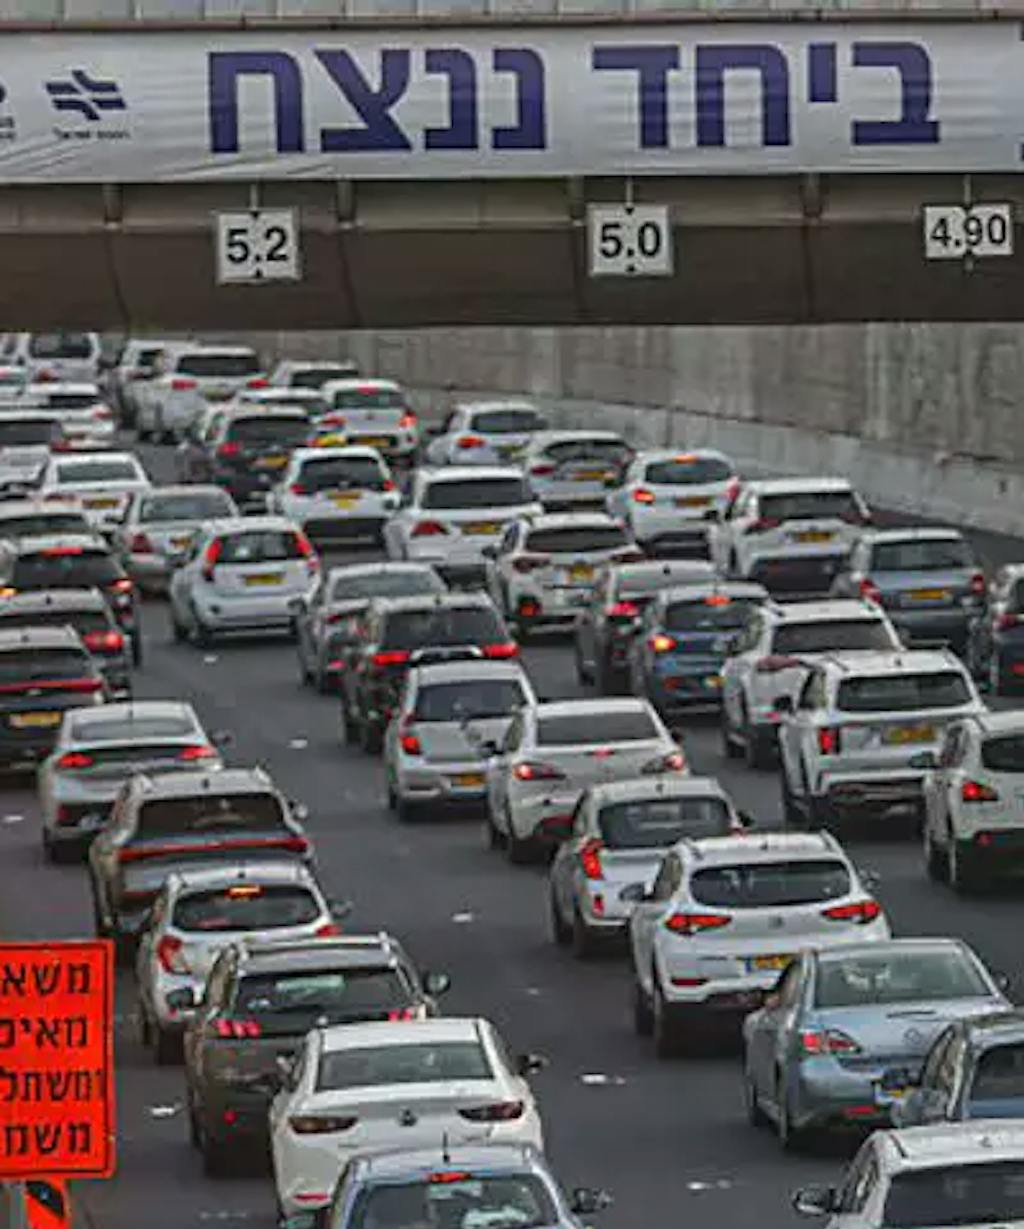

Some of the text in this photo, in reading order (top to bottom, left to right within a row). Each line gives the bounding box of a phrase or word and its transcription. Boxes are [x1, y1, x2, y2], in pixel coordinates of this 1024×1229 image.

[207, 41, 941, 154] ביחד ננצח
[226, 227, 290, 264] 5.2
[598, 223, 662, 260] 5.0
[929, 214, 1008, 249] 4.90
